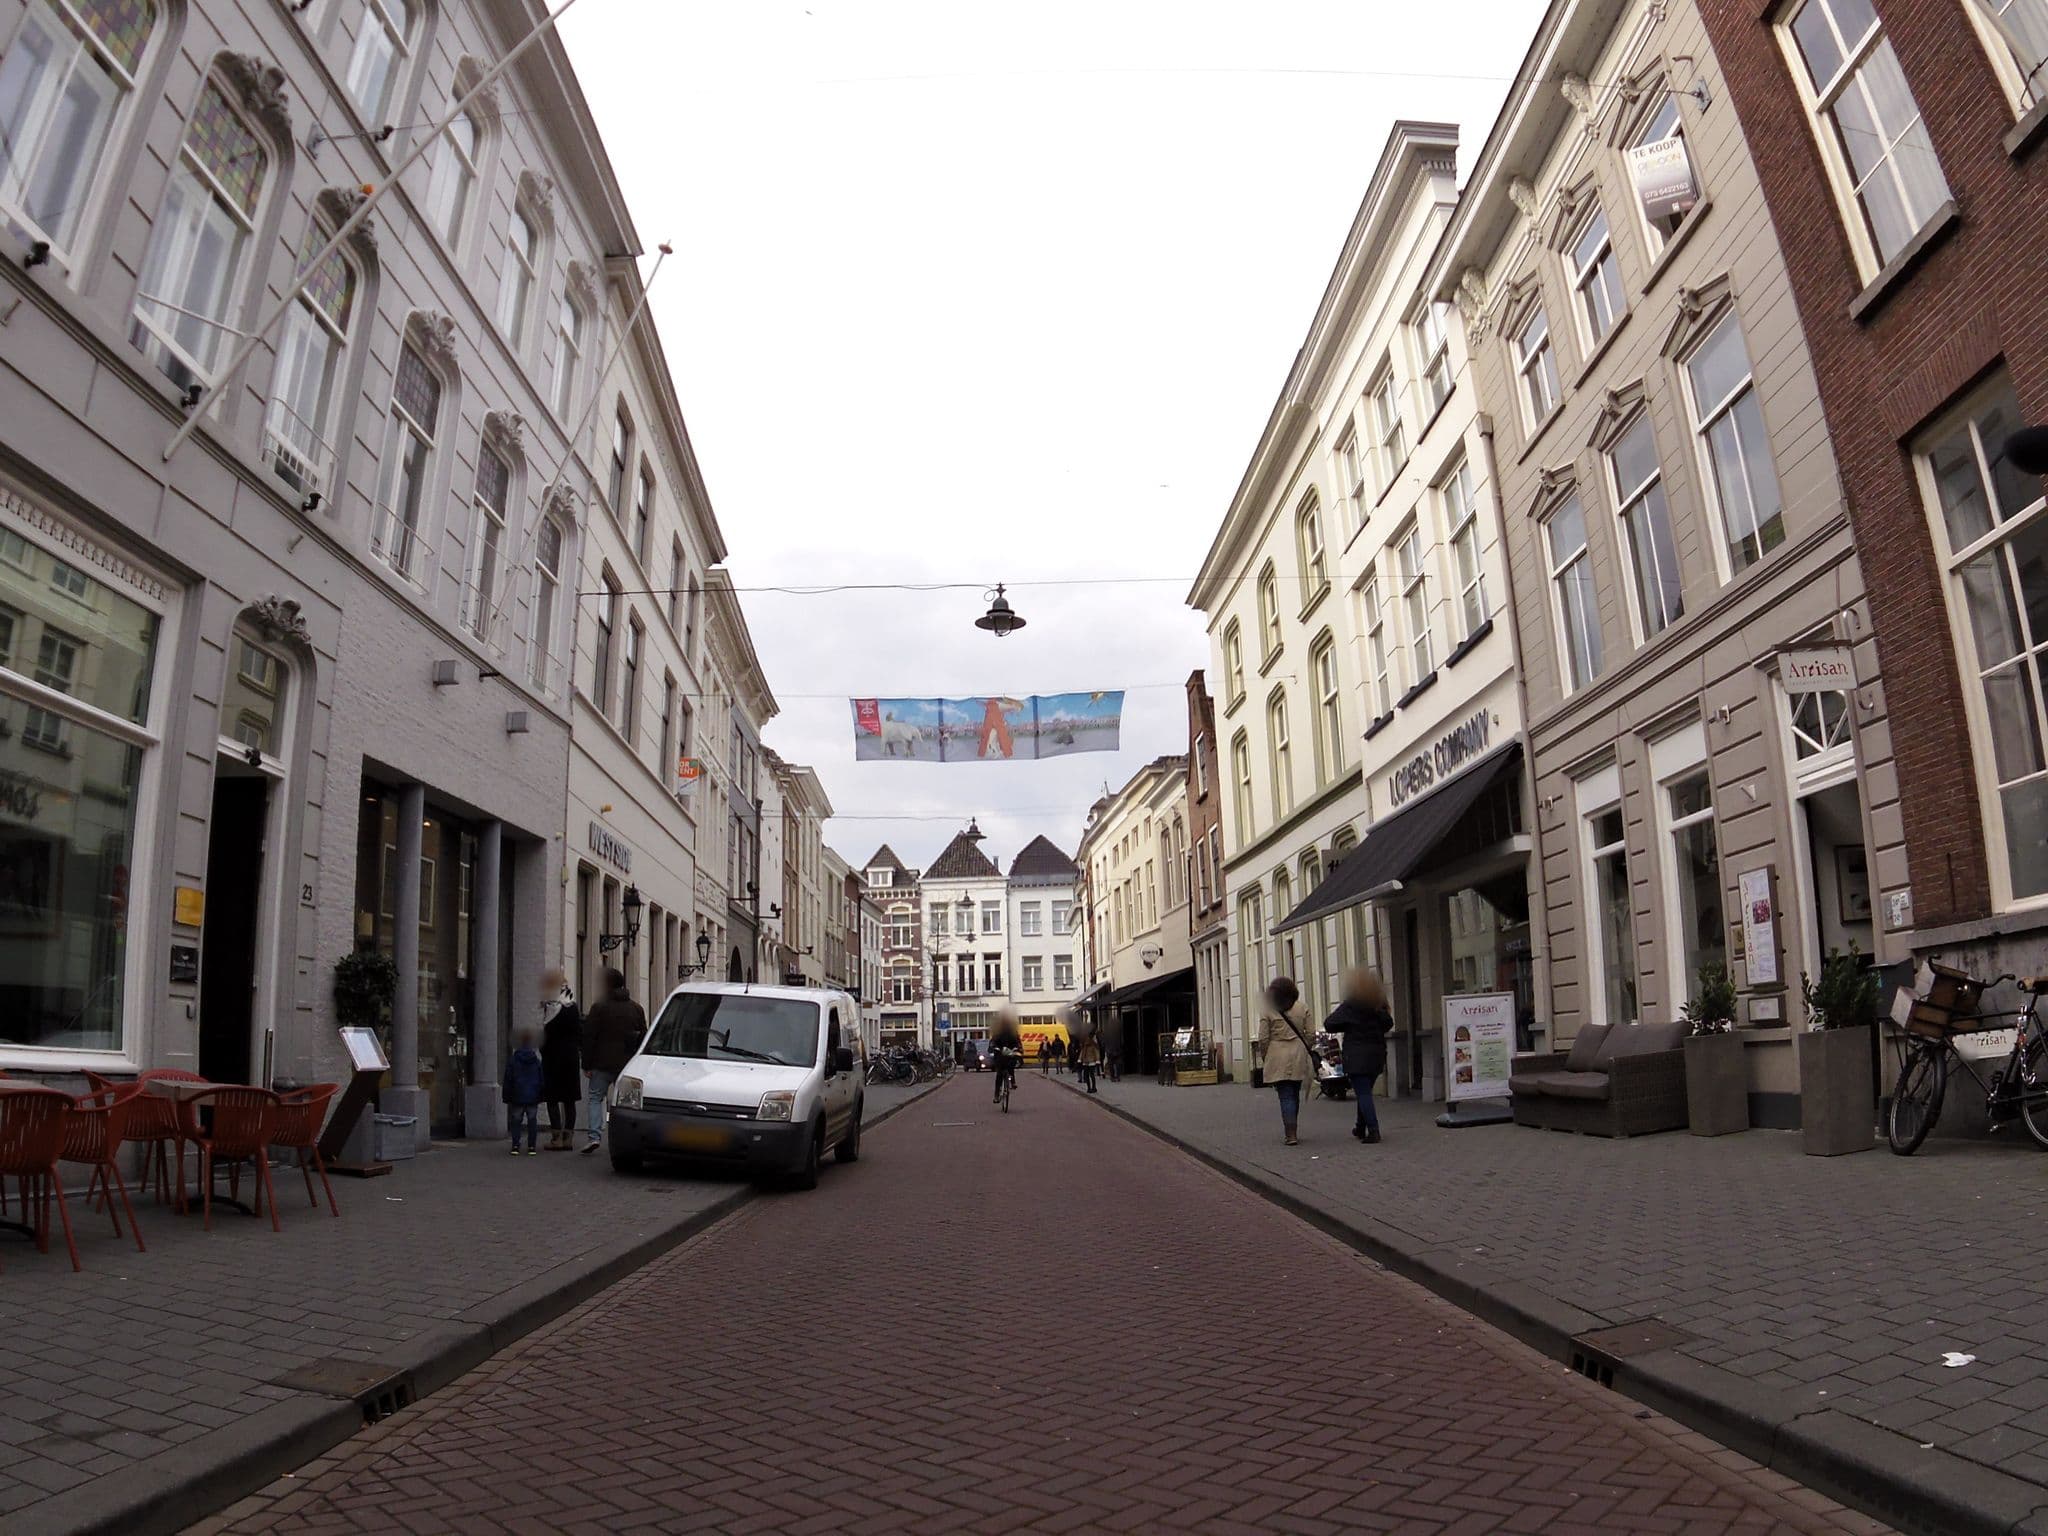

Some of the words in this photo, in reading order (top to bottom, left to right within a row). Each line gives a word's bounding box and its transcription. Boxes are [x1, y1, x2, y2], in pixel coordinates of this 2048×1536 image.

[1633, 149, 1646, 159] TE
[1648, 140, 1677, 155] KOOP
[1789, 660, 1849, 679] Artisan
[1434, 707, 1490, 778] COMPANY
[1461, 1004, 1498, 1015] Artisan
